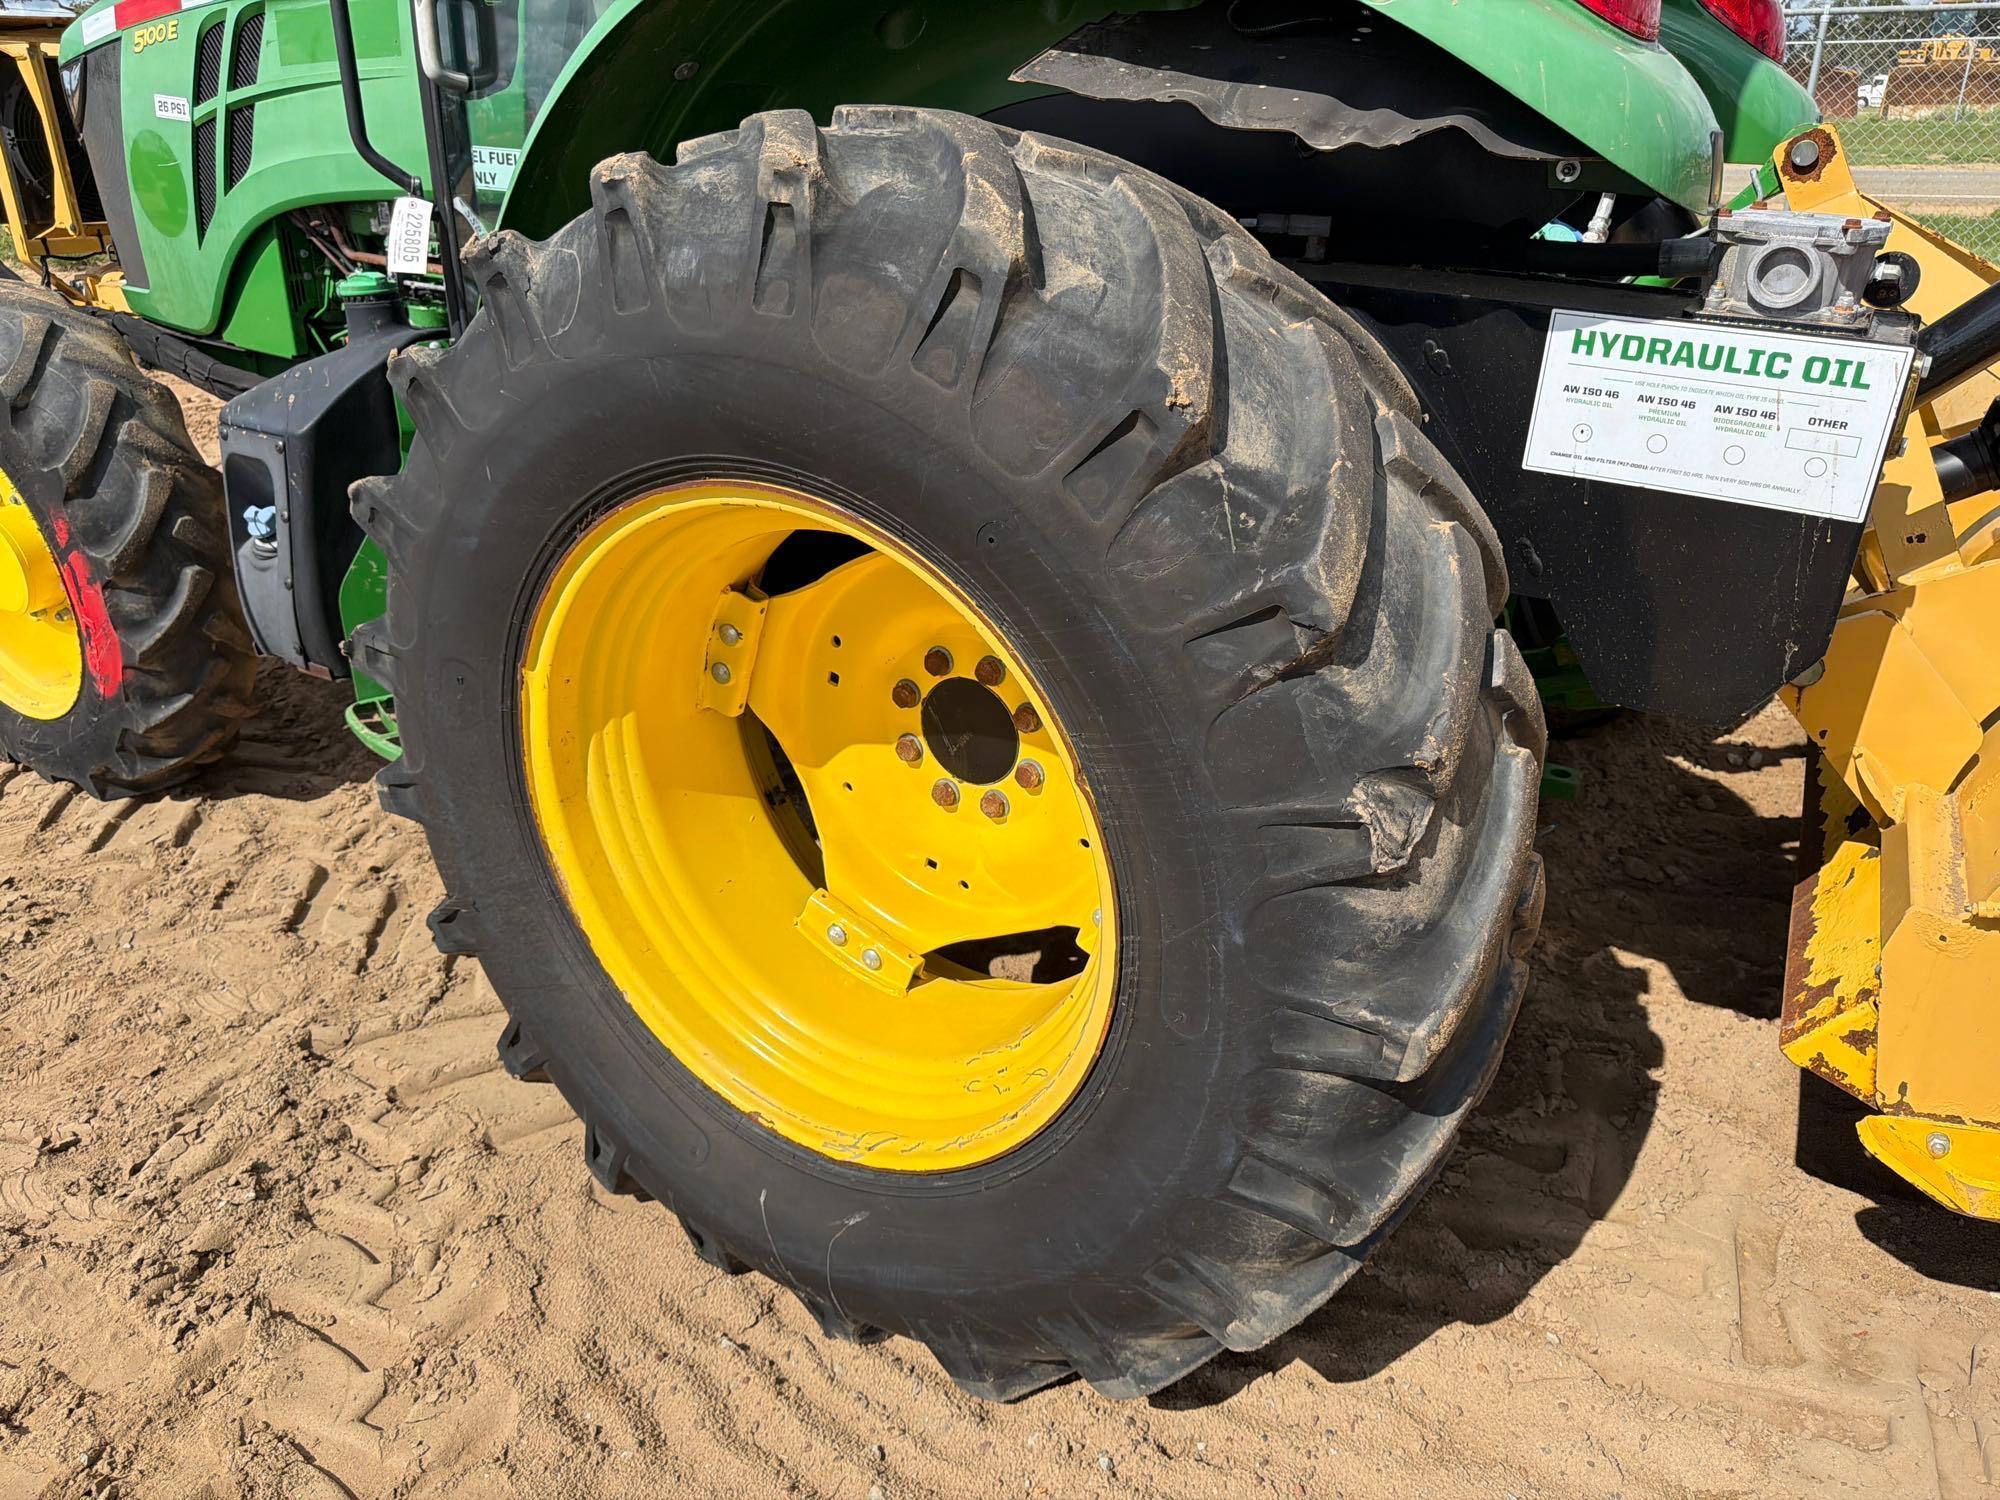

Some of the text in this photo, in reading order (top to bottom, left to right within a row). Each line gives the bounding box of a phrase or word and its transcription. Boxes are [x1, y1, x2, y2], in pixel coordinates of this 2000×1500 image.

[158, 100, 186, 115] 26 PSI
[475, 171, 497, 185] NLY
[403, 212, 423, 263] 225805
[1571, 328, 1871, 390] HYDRAULIC OIL
[1563, 384, 1620, 399] AW ISO 46
[1566, 397, 1613, 409] HYDRAULIC OIL
[1637, 394, 1697, 410] AW ISO 46
[1648, 408, 1681, 418] PREMIUM
[1714, 404, 1777, 420] AW ISO 46
[1638, 415, 1688, 427] HYDRAULIC OIL
[1808, 416, 1848, 430] OTHER
[1715, 425, 1767, 438] HYDRAULIC OIL
[1596, 457, 1617, 465] FILTER
[1650, 465, 1666, 473] AFTER
